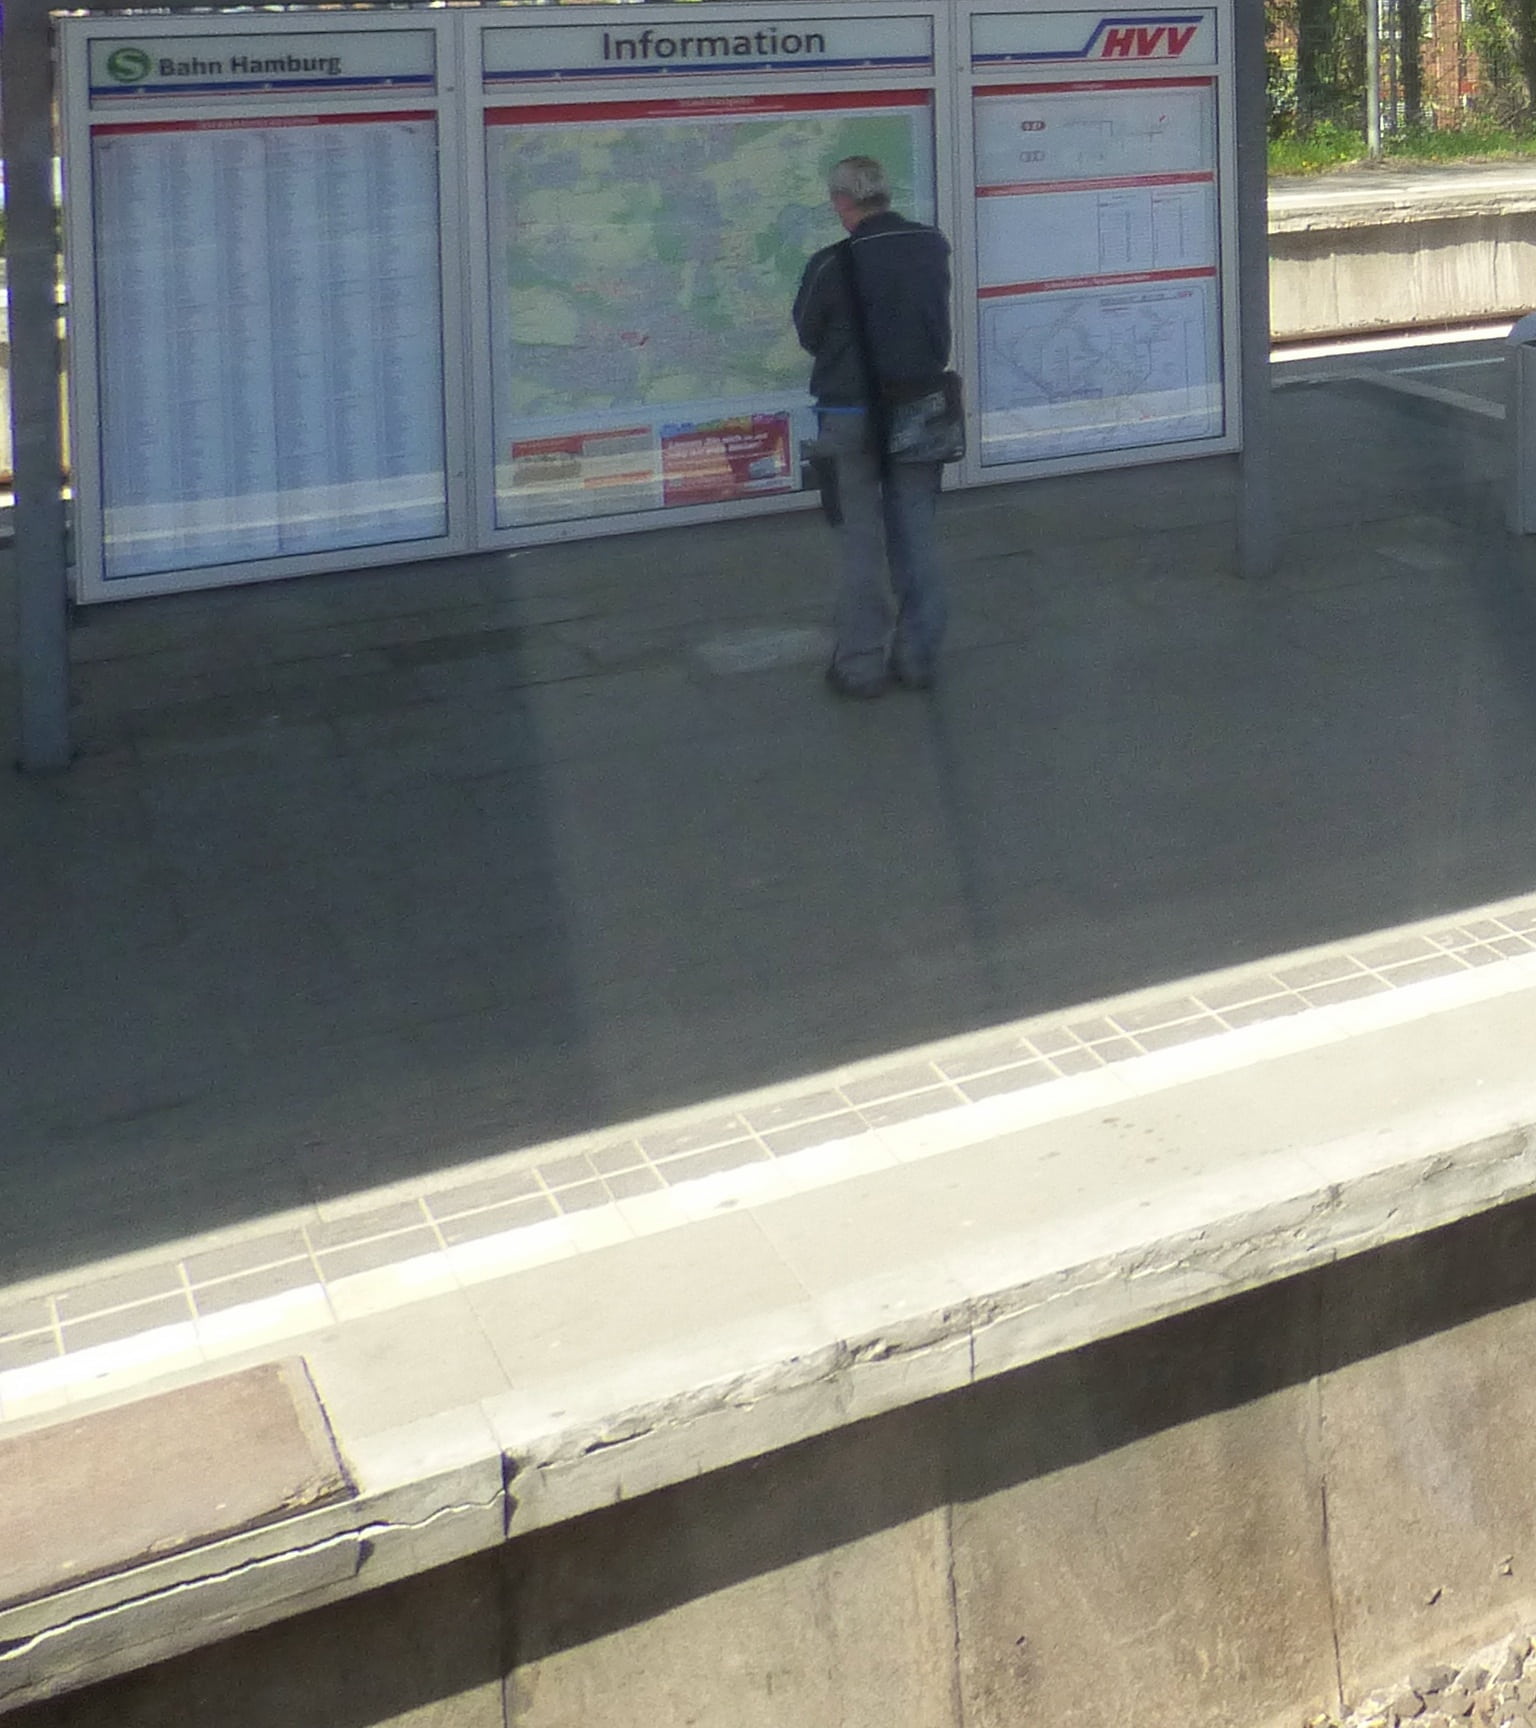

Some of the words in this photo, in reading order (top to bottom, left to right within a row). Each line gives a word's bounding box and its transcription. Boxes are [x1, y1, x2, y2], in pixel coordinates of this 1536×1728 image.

[603, 26, 825, 60] Information
[1101, 26, 1198, 57] HVV
[159, 56, 223, 77] Bahn
[230, 54, 343, 77] Hamburg
